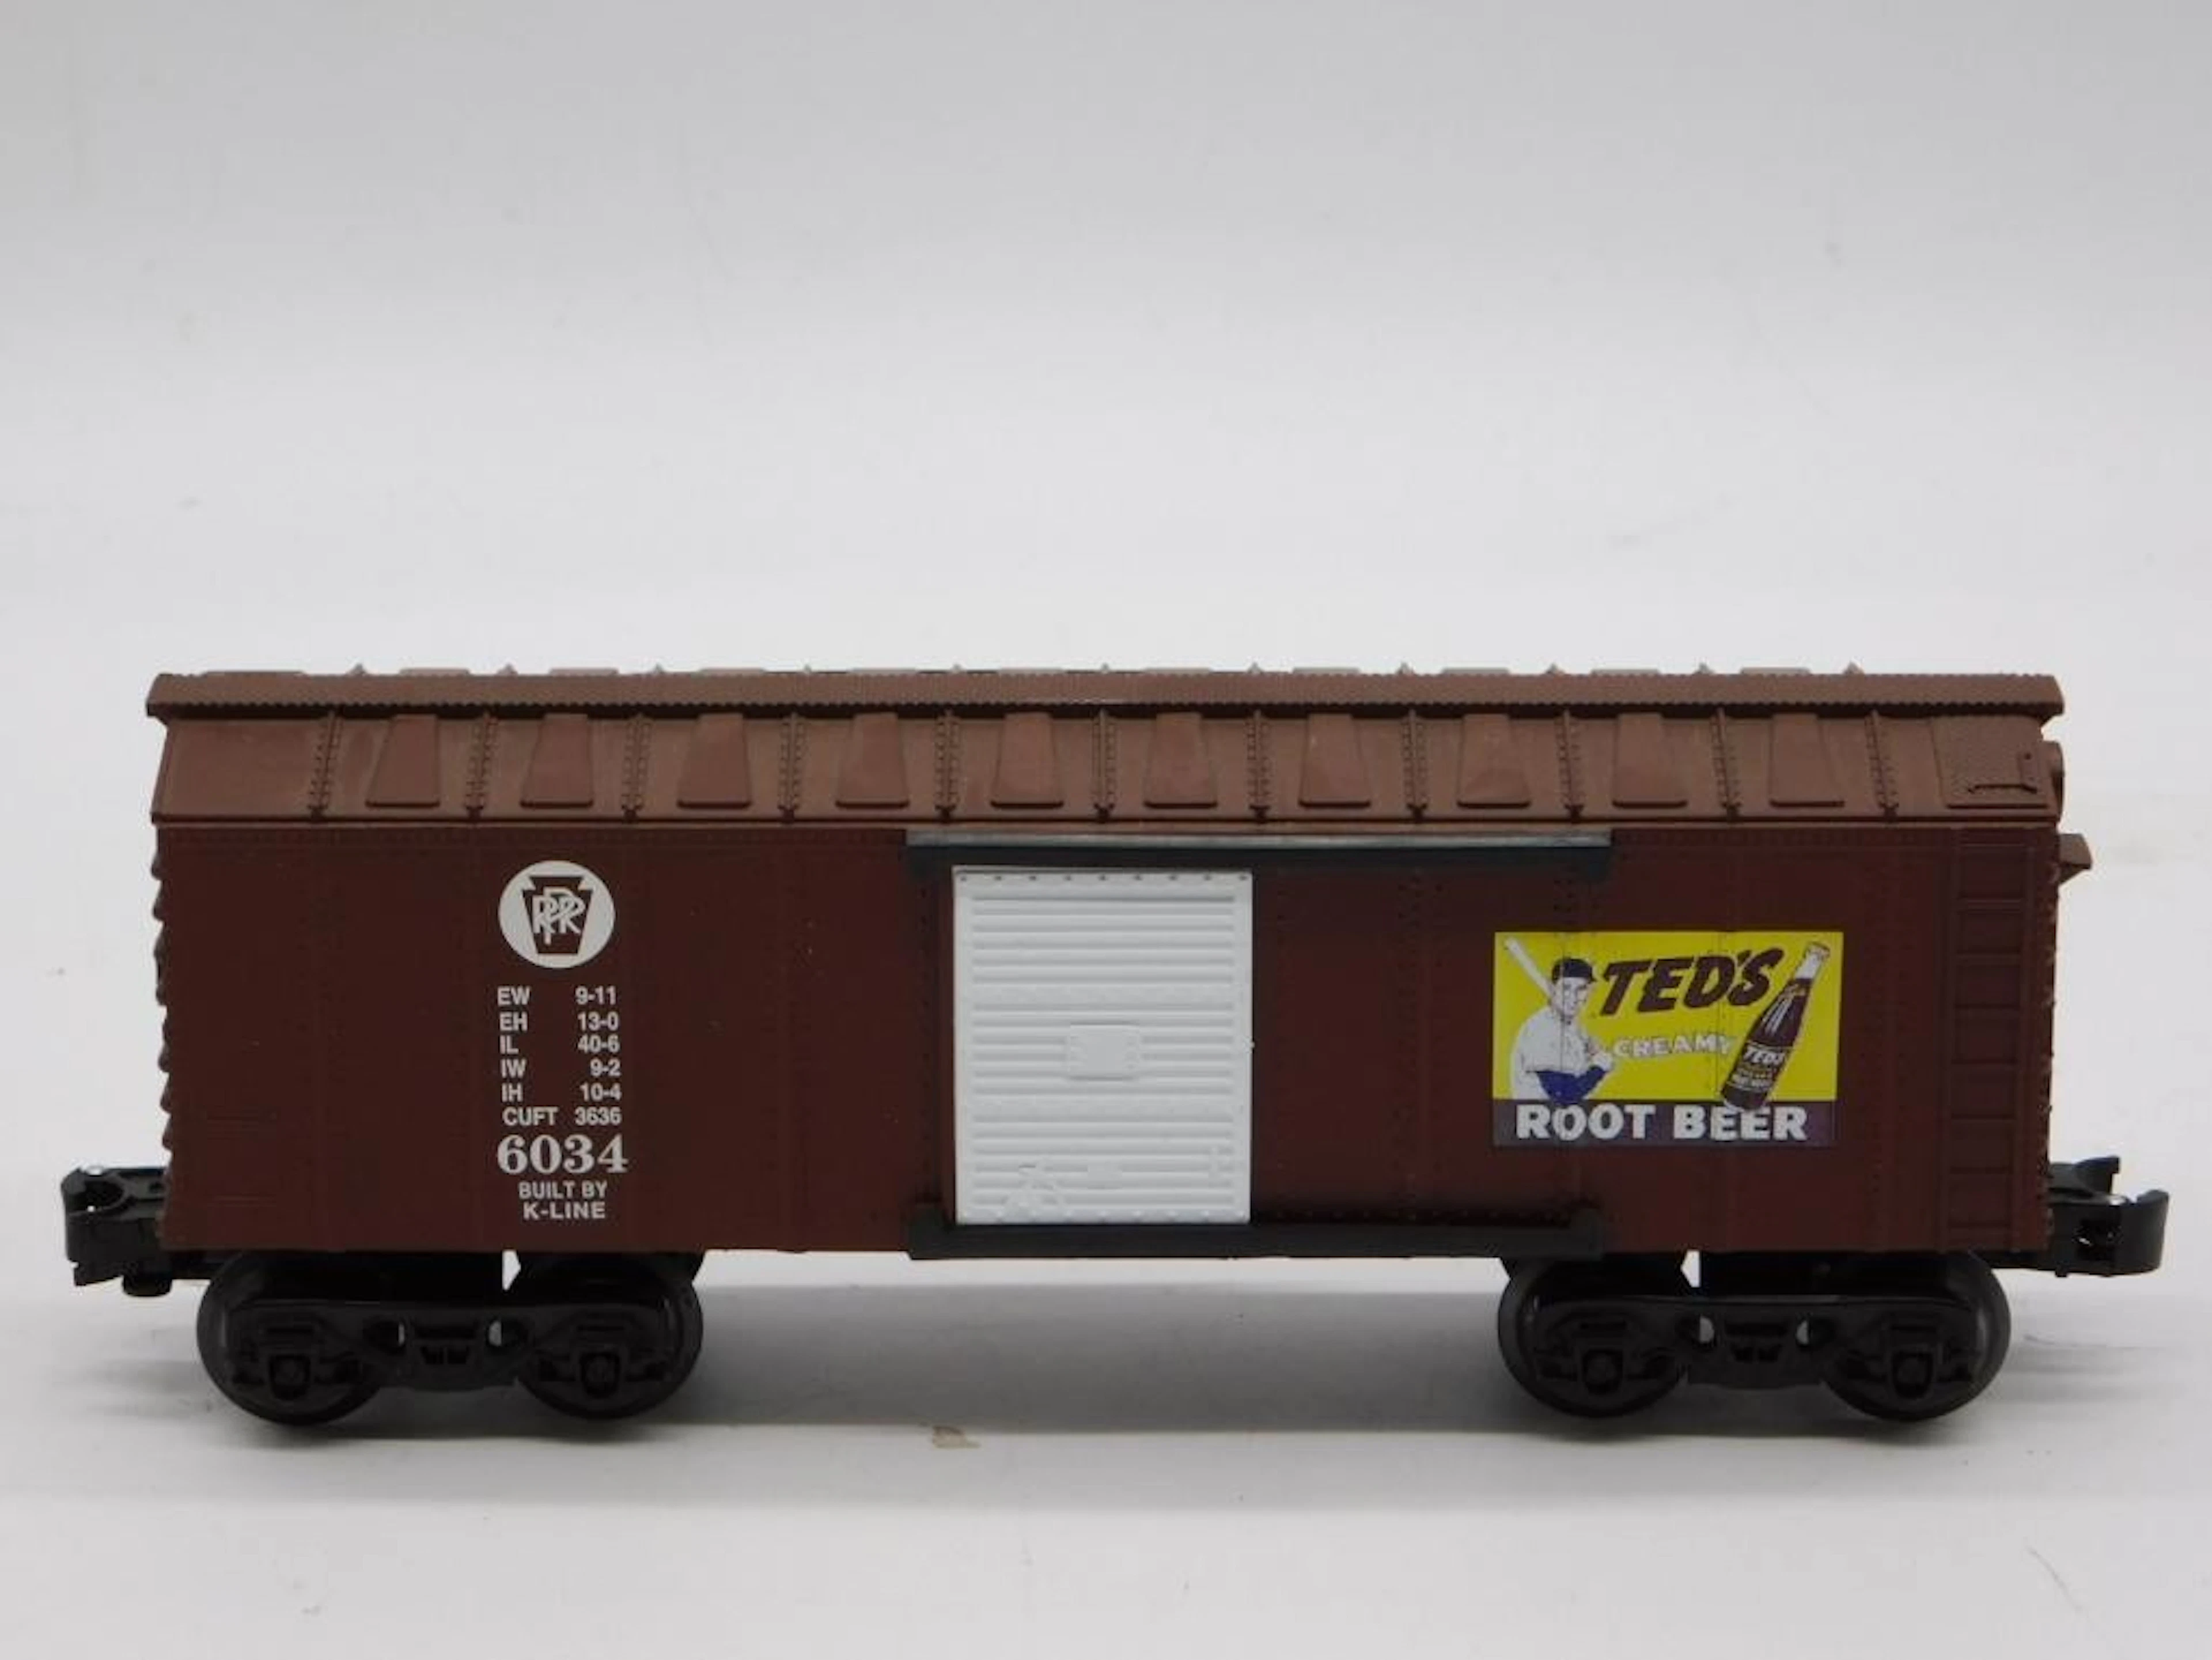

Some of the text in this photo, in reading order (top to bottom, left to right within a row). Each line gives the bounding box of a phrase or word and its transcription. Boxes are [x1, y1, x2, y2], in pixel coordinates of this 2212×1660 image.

[1600, 948, 1784, 1015] TED'S
[497, 986, 616, 1006] EW 9-11
[499, 1011, 619, 1031] EH 13-0
[499, 1034, 620, 1054] IL 40-6
[1613, 1033, 1734, 1058] CREAMY
[501, 1058, 622, 1078] IW 9-2
[501, 1083, 622, 1102] IH 10-4
[502, 1106, 622, 1126] CUFT 3636
[1516, 1103, 1808, 1141] ROOT BEER
[497, 1133, 628, 1175] 6034
[518, 1181, 608, 1200] BUILT BY
[523, 1201, 606, 1220] K-LINE
